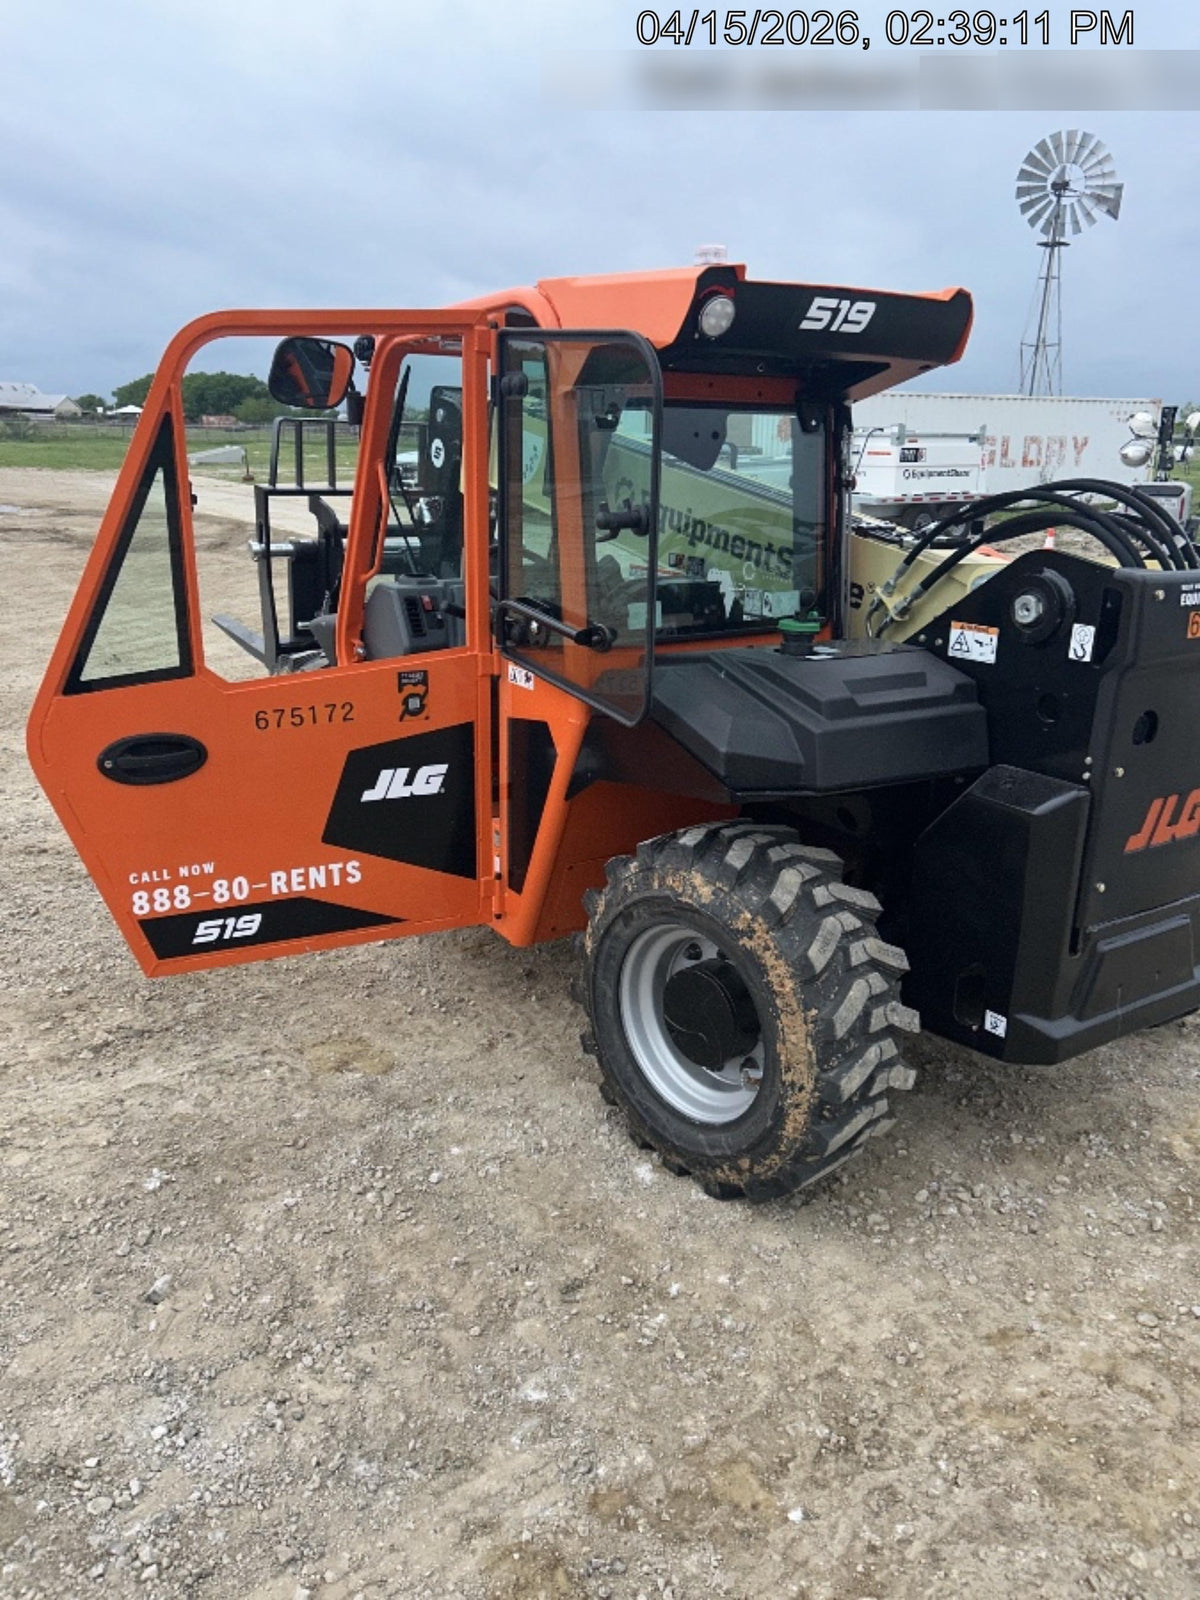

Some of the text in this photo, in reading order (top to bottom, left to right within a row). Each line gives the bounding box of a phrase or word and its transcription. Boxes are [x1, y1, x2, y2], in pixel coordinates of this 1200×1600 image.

[799, 297, 876, 333] 519
[255, 702, 354, 730] 675172
[360, 764, 449, 802] JLG
[129, 862, 214, 884] CALL NOW
[132, 861, 362, 915] 888-80-RENTS
[192, 913, 262, 945] 519
